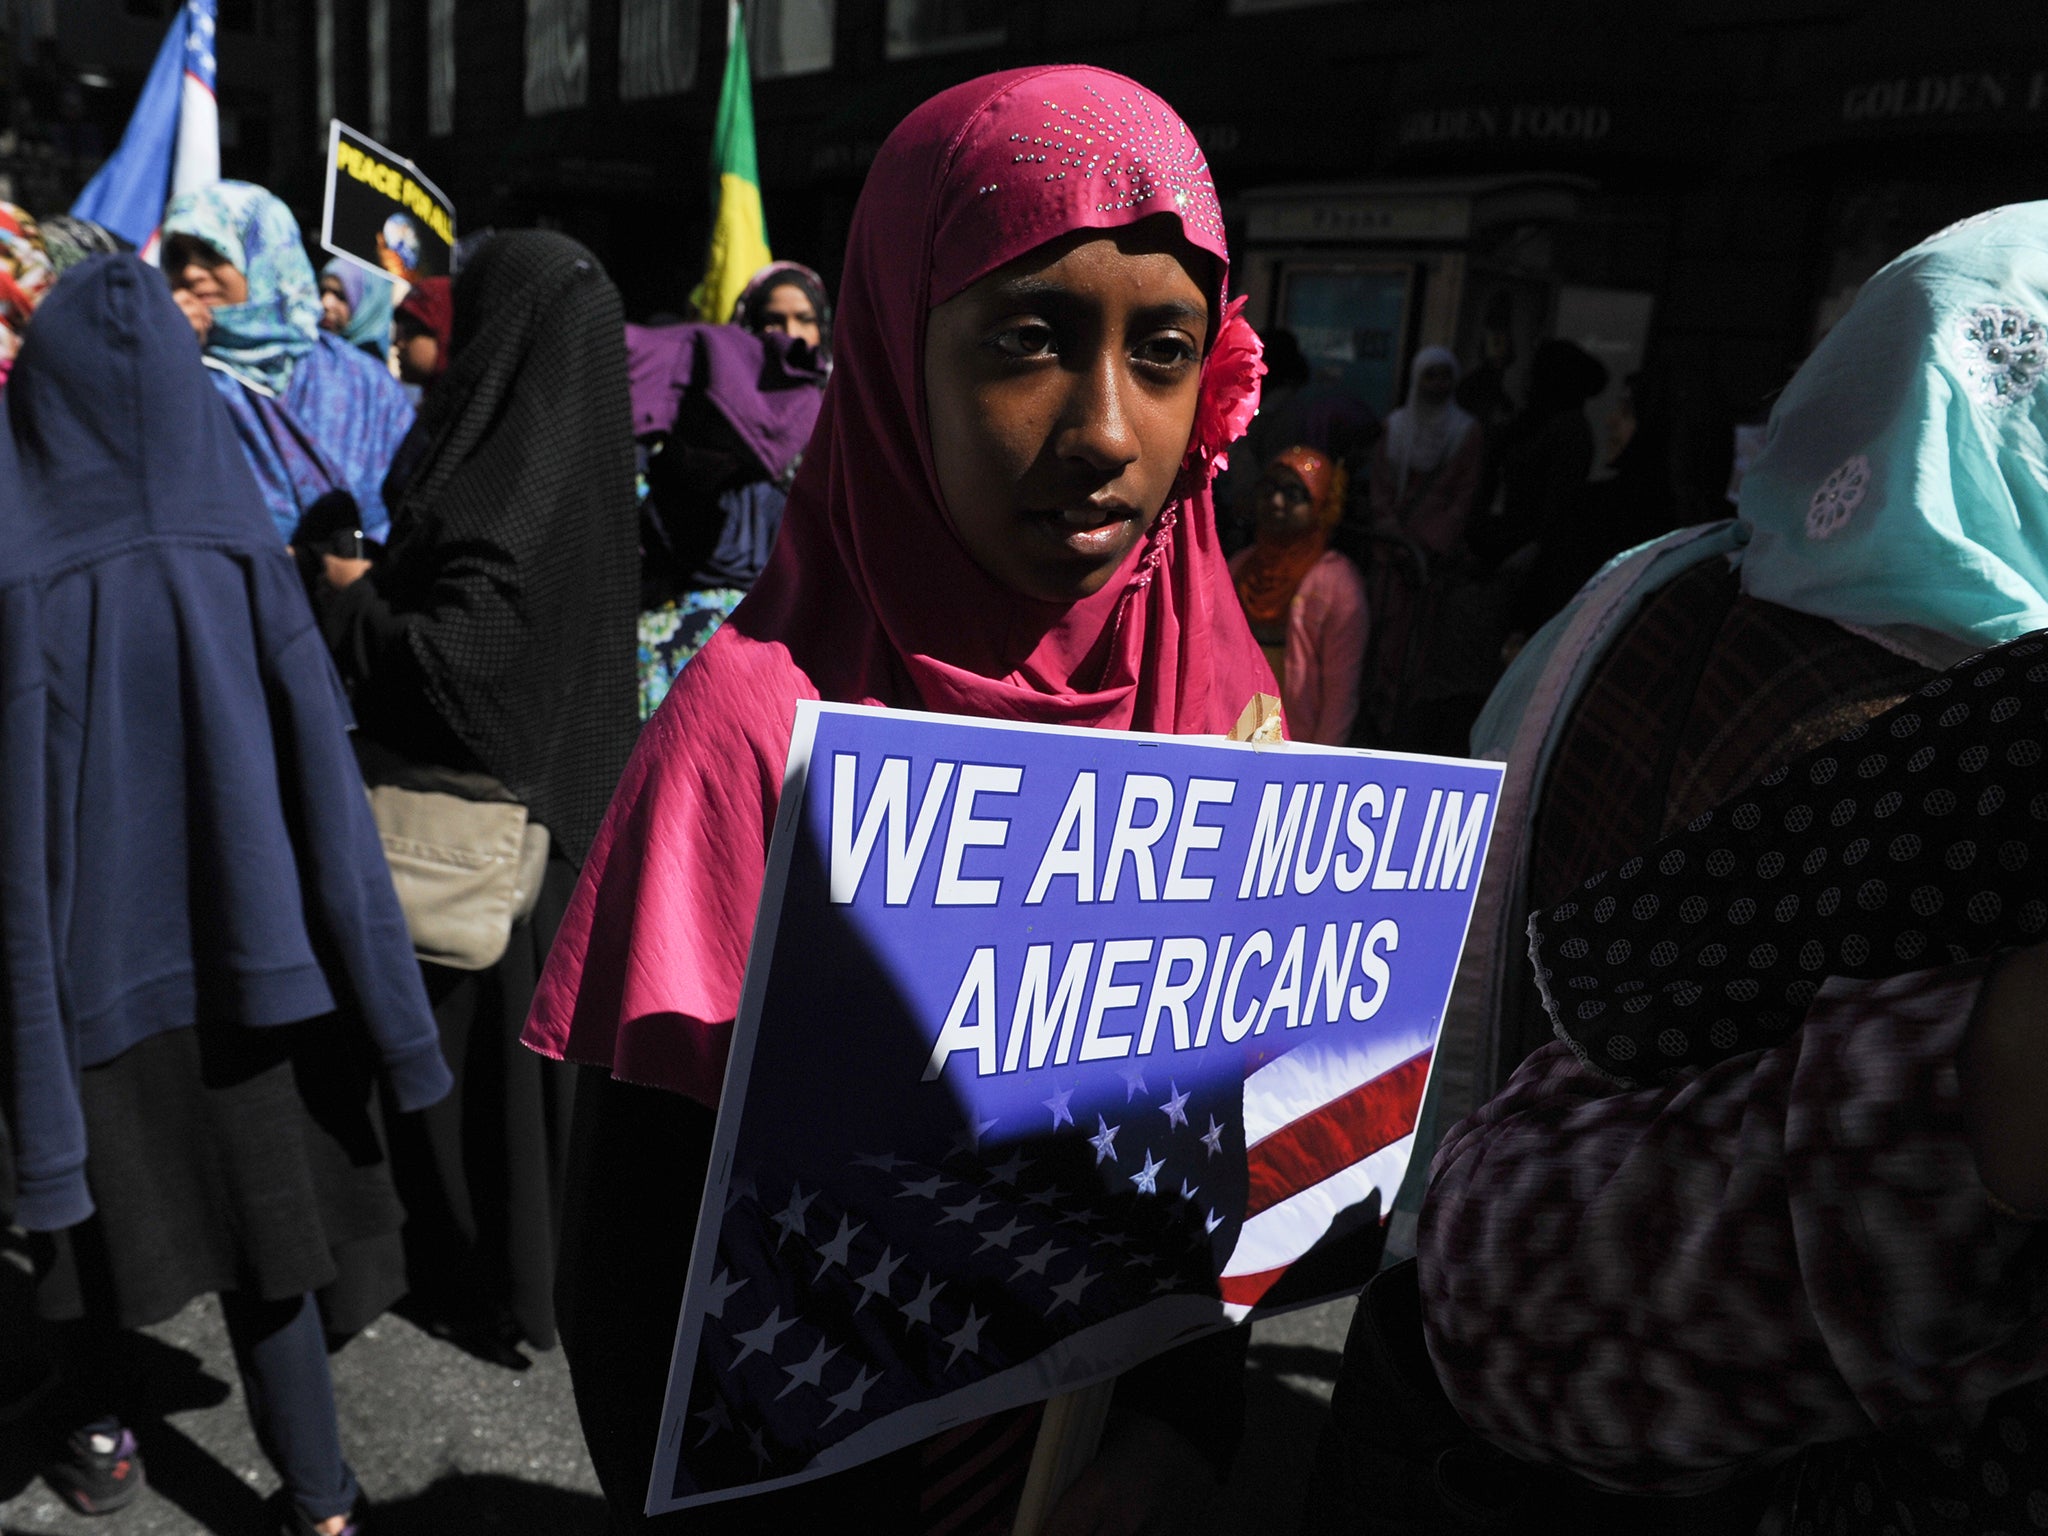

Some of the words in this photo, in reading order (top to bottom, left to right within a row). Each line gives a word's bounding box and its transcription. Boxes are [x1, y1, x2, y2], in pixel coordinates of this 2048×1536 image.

[1509, 103, 1611, 140] FOOD
[1843, 73, 2009, 120] GOLDEN
[337, 141, 404, 205] PEACE
[829, 752, 1024, 906] WE
[1022, 769, 1238, 905] ARE
[1236, 781, 1490, 901] MUSLIM
[921, 918, 1400, 1081] AMERICANS
